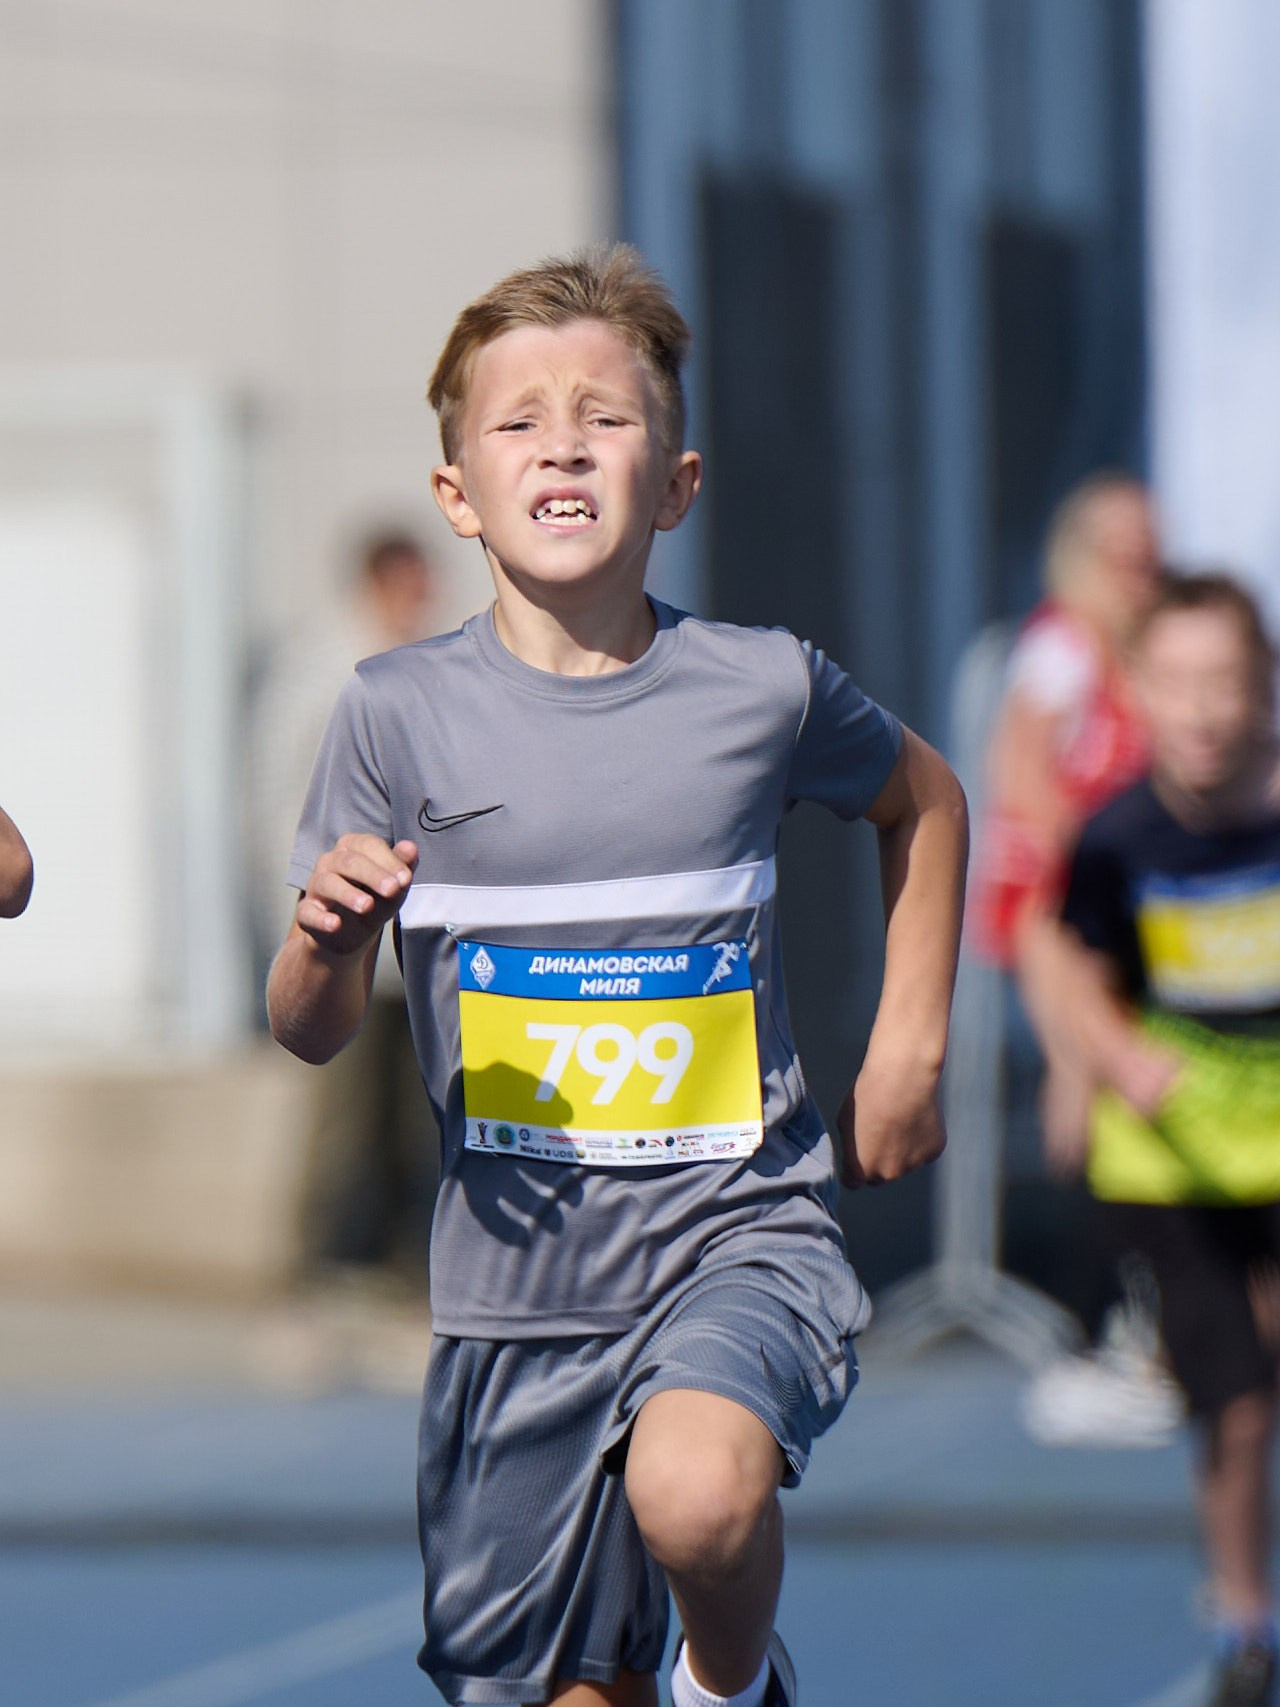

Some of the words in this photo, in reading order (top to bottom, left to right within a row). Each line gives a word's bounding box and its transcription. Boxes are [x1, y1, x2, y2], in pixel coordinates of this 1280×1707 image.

[528, 953, 689, 975] ДИНАМОВСКАЯ
[579, 977, 641, 996] МИЛЯ
[525, 1021, 694, 1105] 799
